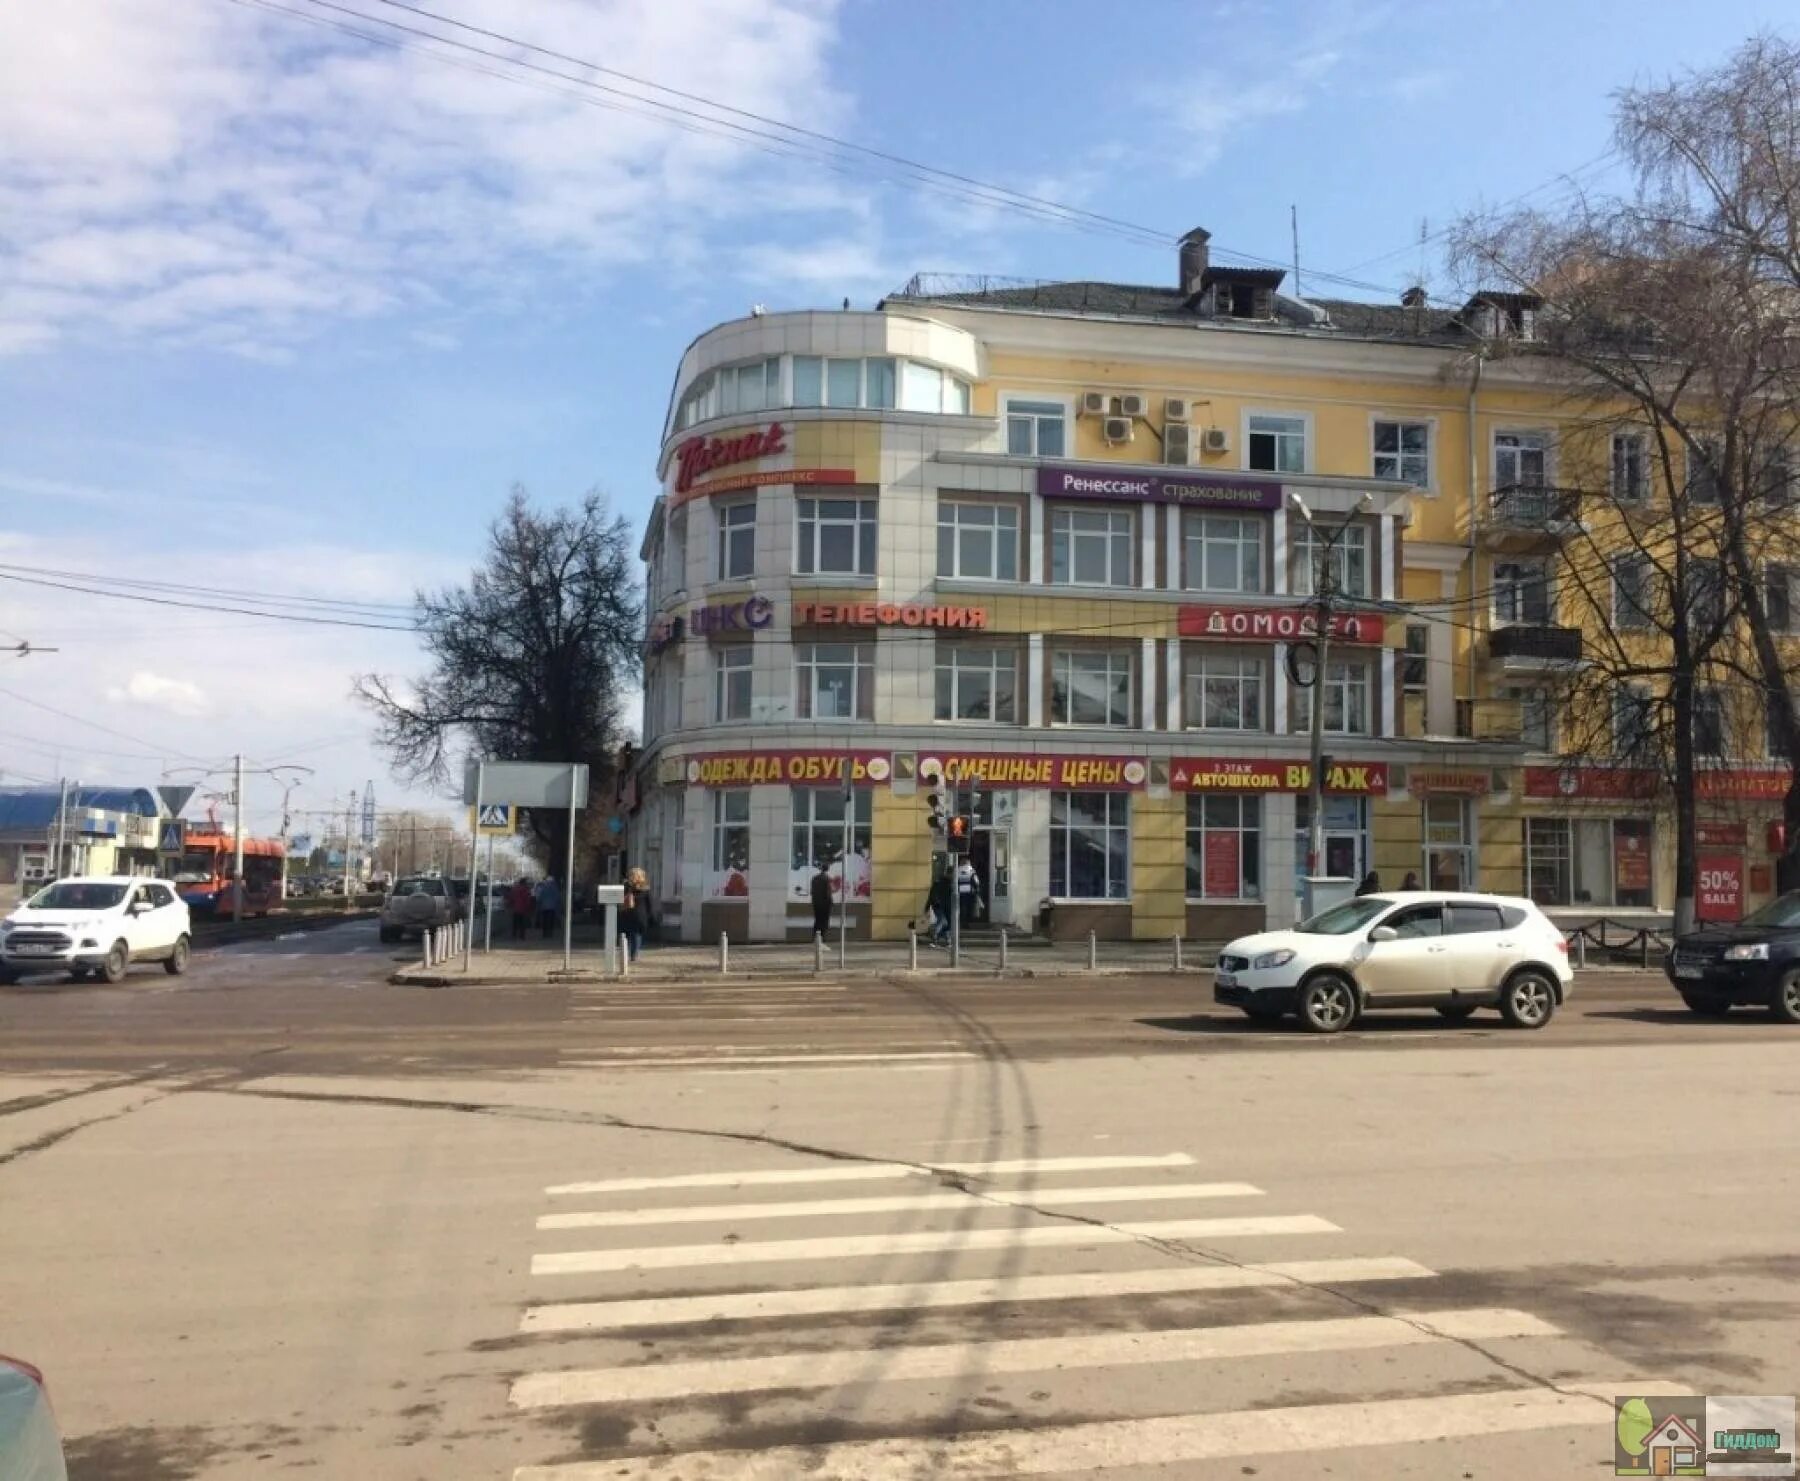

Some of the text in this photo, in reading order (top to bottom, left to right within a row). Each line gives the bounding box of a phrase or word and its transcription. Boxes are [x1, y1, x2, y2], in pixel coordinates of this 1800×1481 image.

[1063, 473, 1263, 502] Ренессанс страхование
[799, 603, 988, 629] ТЕЛЕФОНИЯ
[700, 758, 782, 783] ОДЕЖДА
[945, 758, 1120, 786] СМЕШНЫЕ ЦЕНЫ
[1192, 772, 1280, 787] АВТОШКОЛА
[1224, 764, 1252, 773] ЭТАЖ
[1700, 870, 1739, 890] 50%
[1703, 894, 1736, 904] SALE
